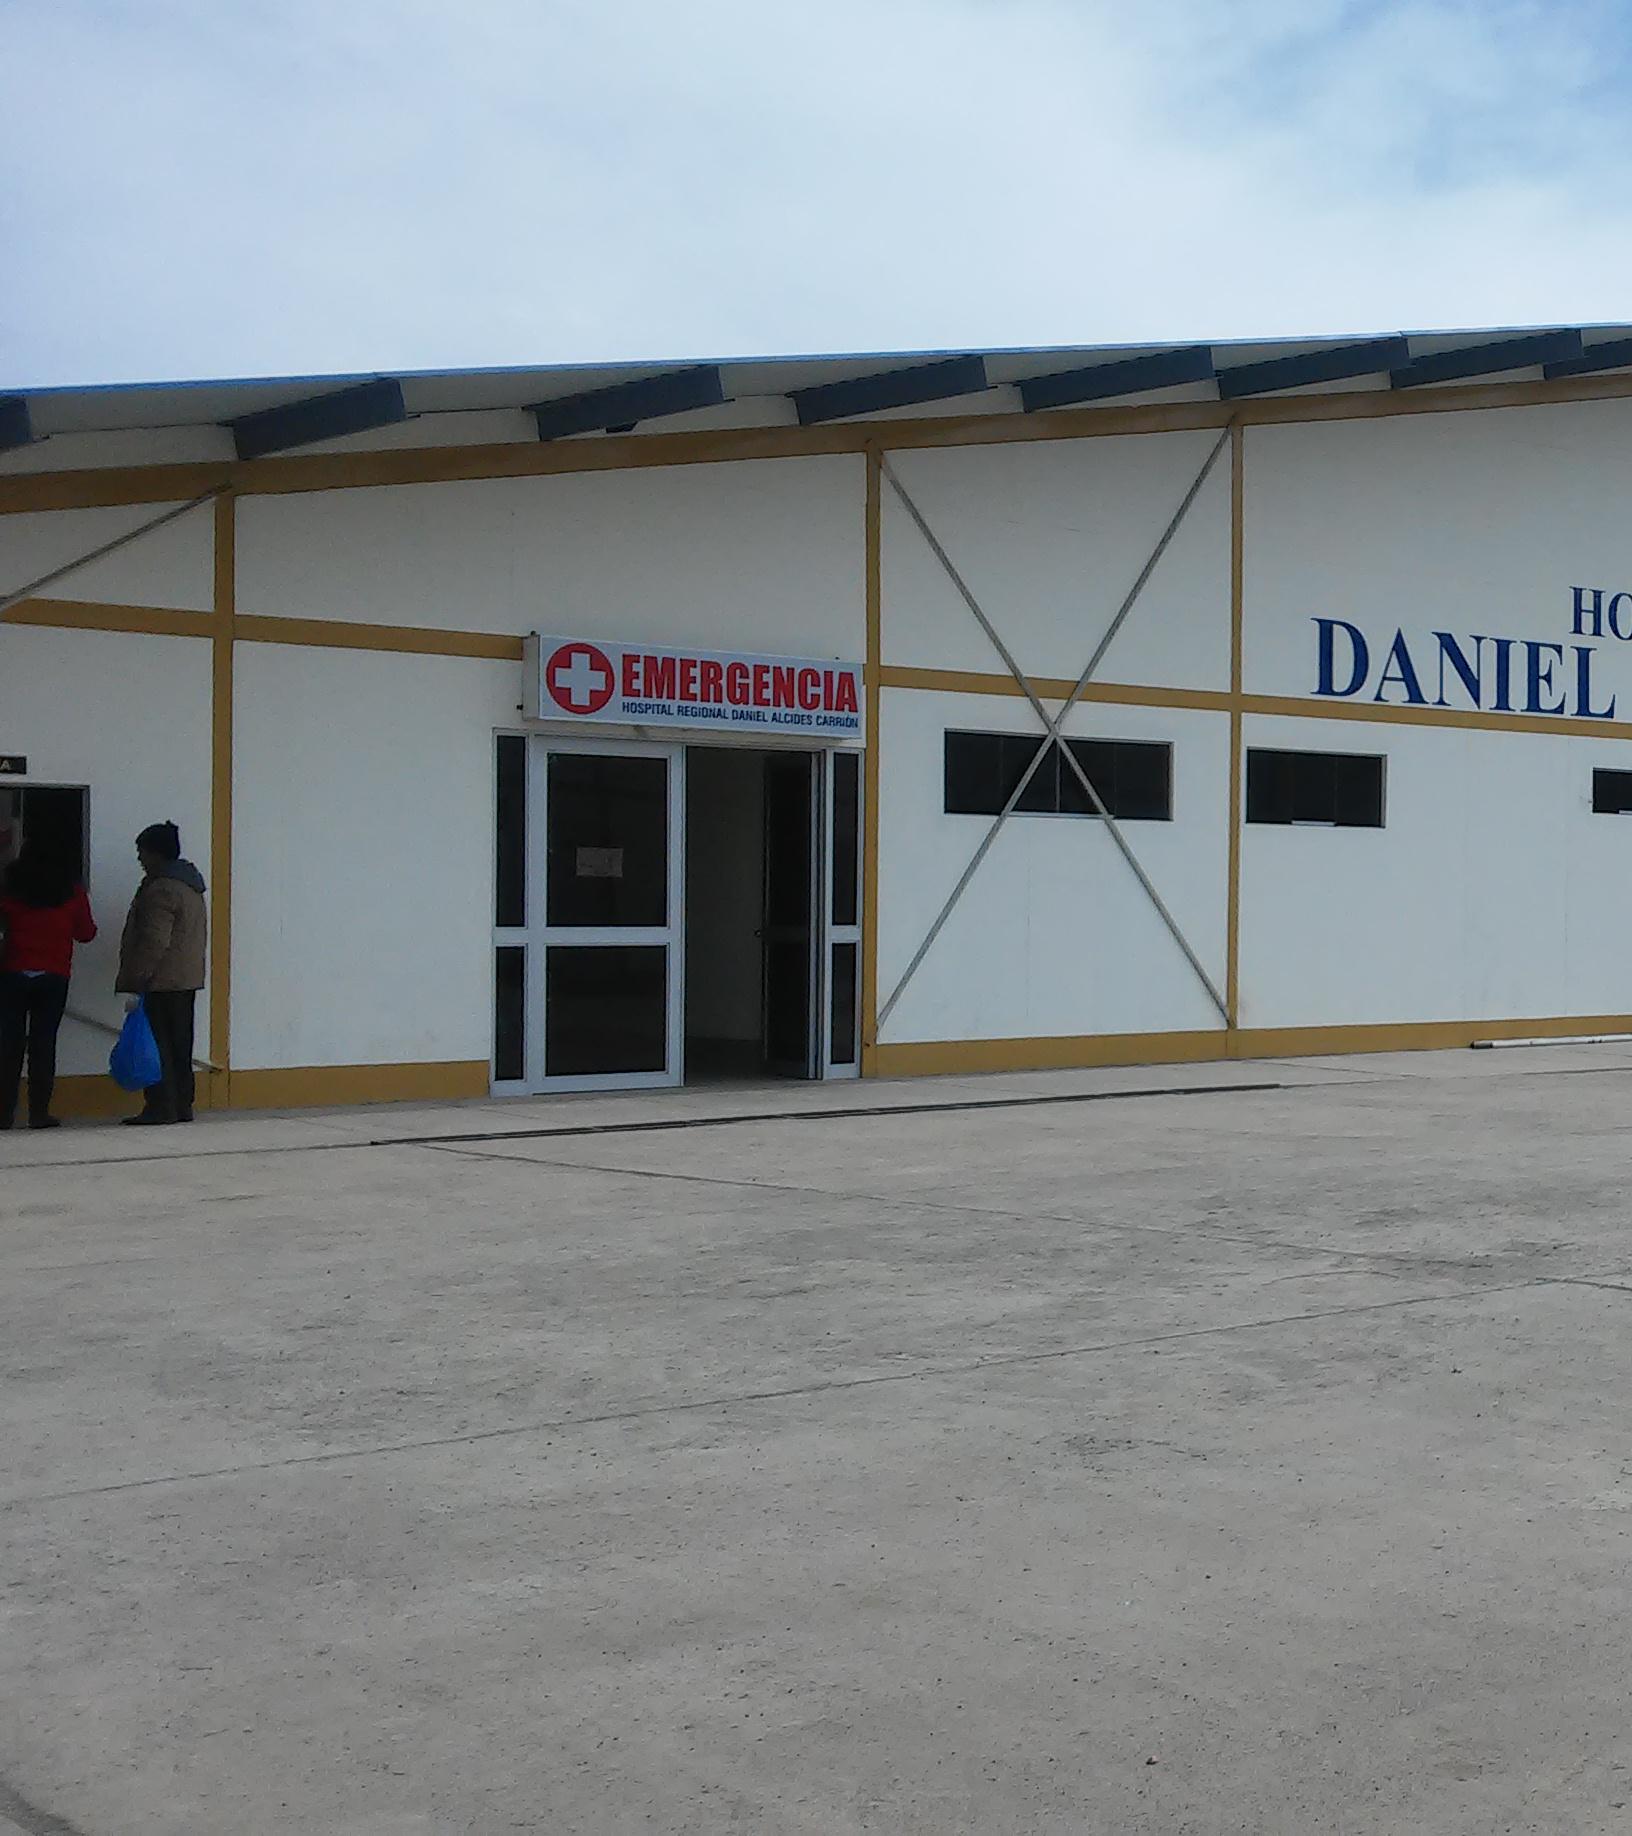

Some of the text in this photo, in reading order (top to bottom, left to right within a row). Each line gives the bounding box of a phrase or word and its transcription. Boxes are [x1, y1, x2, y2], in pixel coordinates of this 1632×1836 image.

[622, 654, 858, 712] EMERGENCIA
[1310, 617, 1616, 719] DANIEL
[622, 701, 859, 729] HOSPITAL REGIONAL DANIEL ALCIDES CARRIÓN
